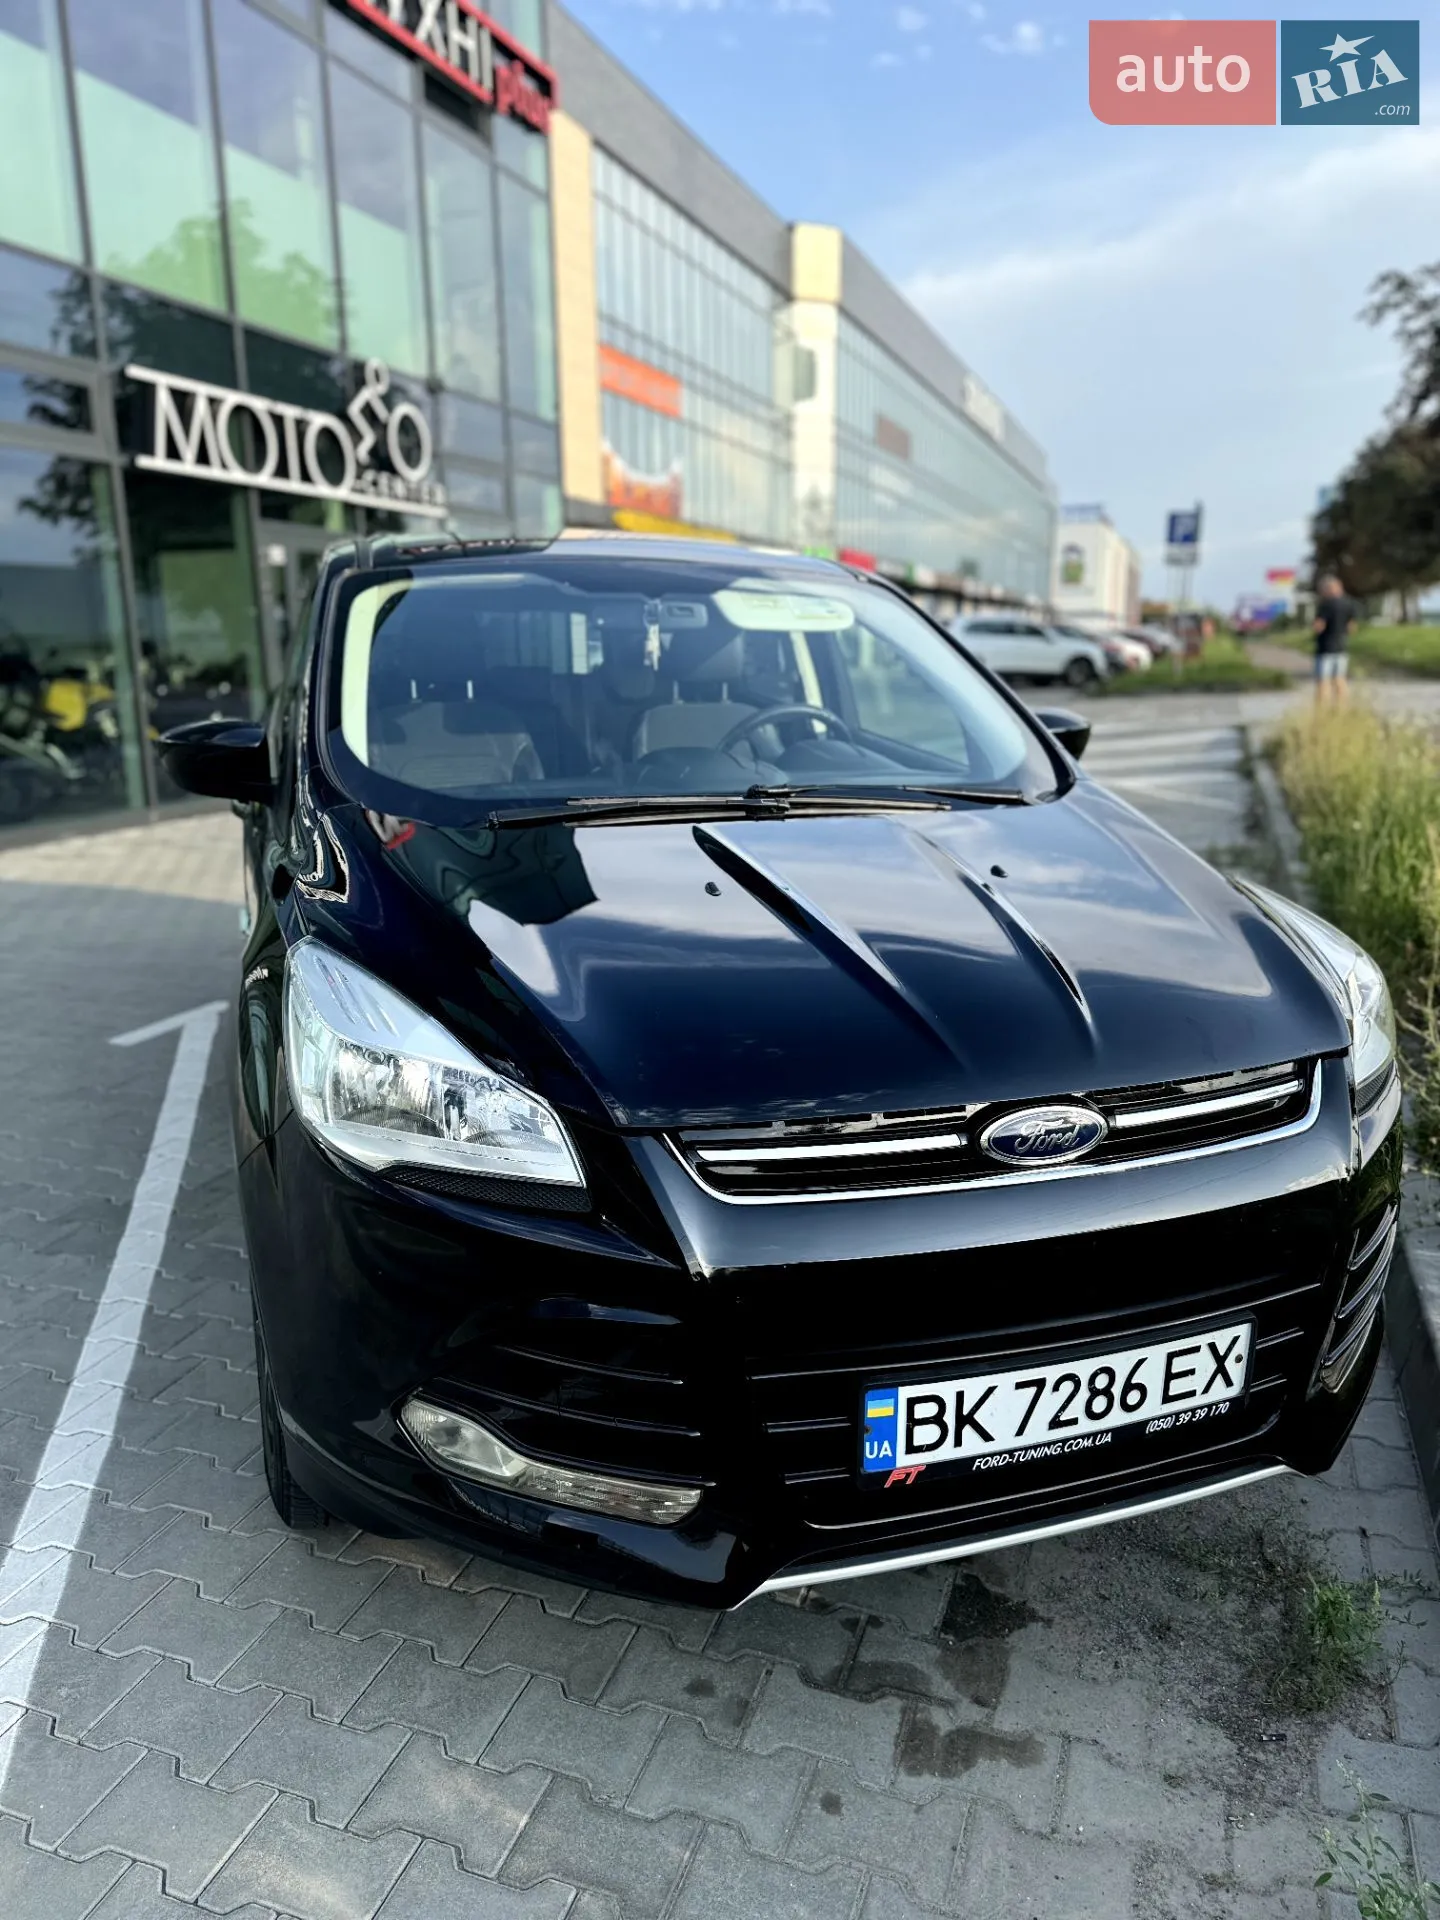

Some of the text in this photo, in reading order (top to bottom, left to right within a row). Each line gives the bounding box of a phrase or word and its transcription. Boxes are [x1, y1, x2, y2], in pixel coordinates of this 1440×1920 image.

[1014, 1118, 1081, 1154] Ford
[905, 1335, 1242, 1455] BK 7286 EX
[1145, 1401, 1230, 1434] (050) 39 39 170
[865, 1440, 893, 1459] UA
[972, 1431, 1112, 1471] FORD-TUNING.COM.UA
[884, 1464, 927, 1488] FT
